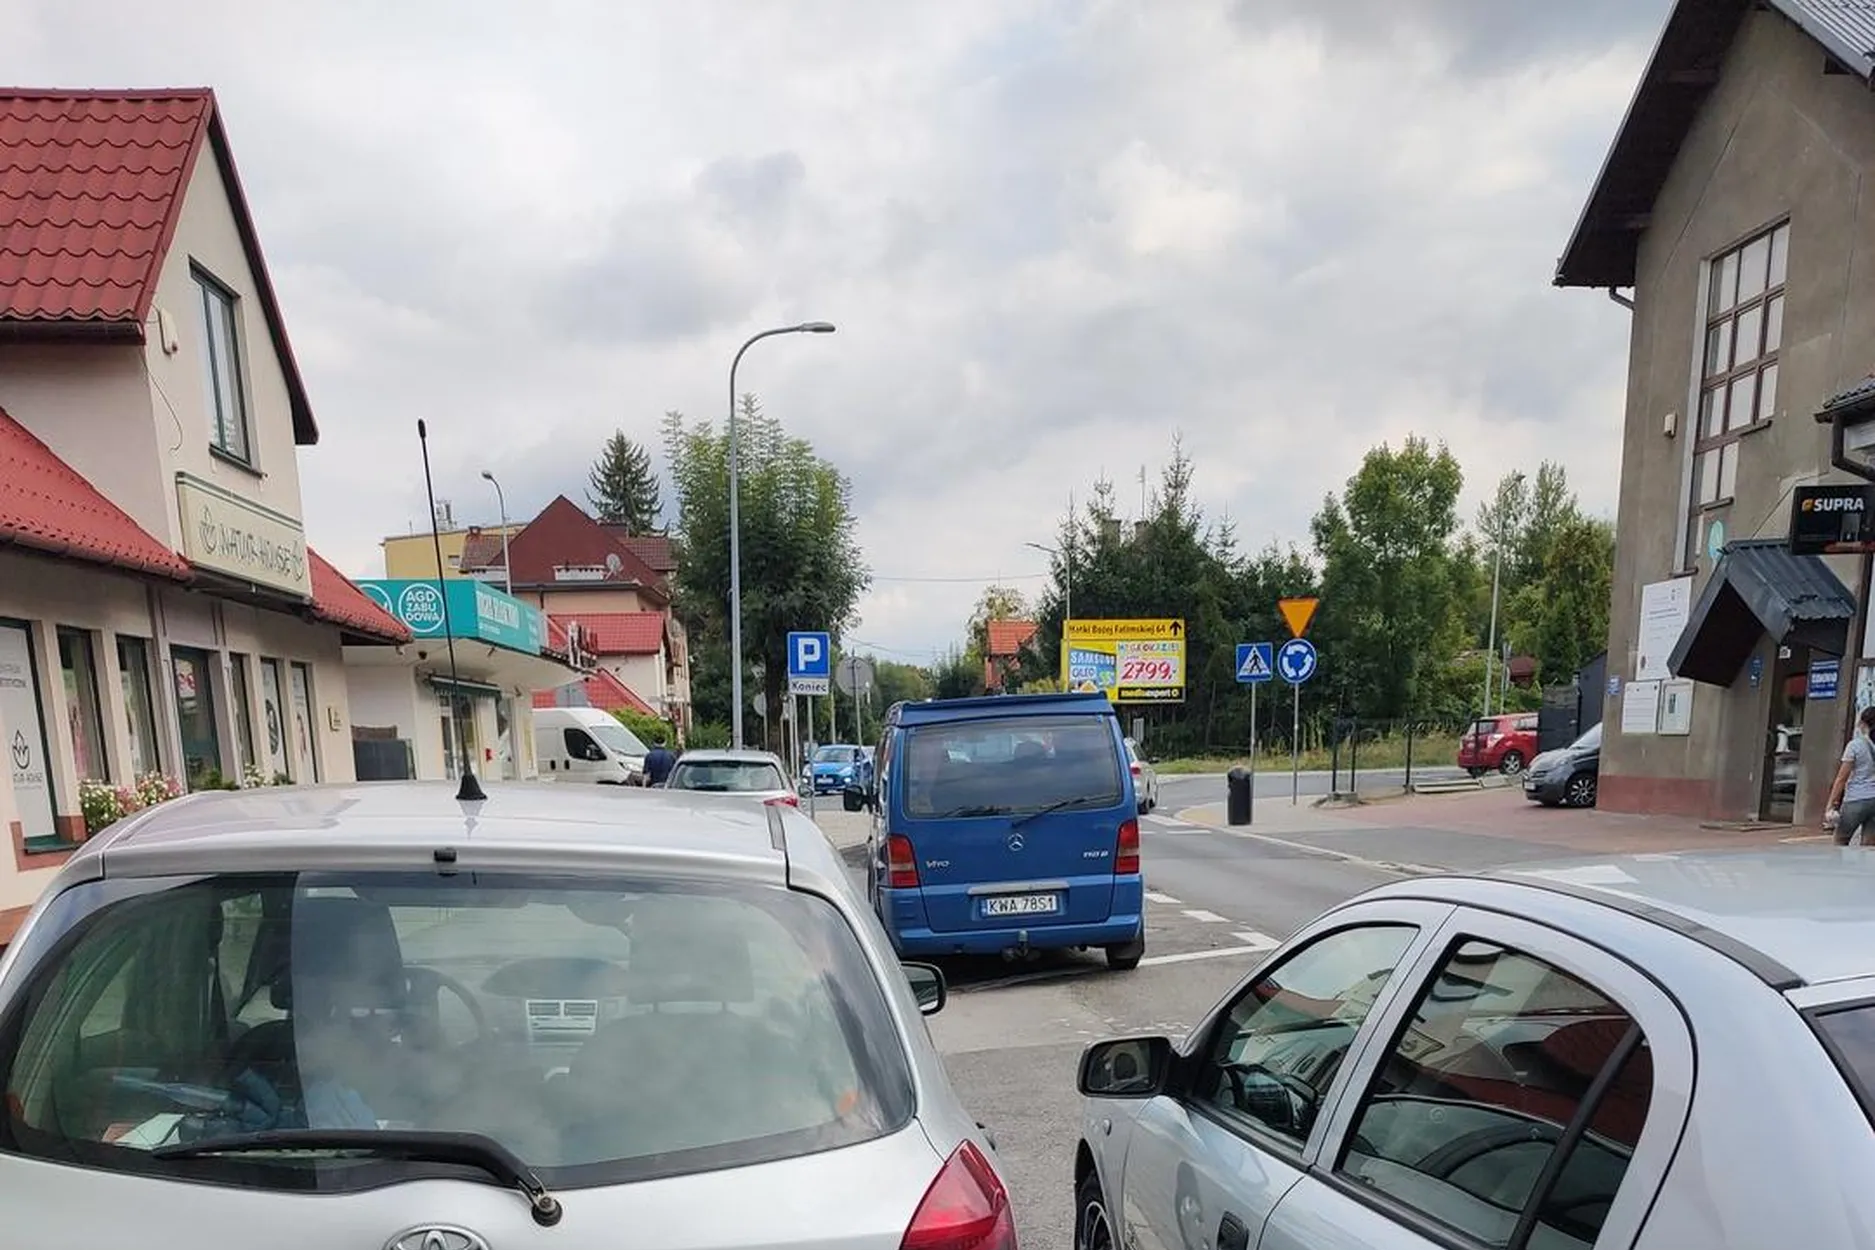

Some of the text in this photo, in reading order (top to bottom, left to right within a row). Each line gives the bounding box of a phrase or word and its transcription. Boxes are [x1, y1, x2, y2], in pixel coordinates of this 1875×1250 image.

[1813, 498, 1864, 511] SUPRA
[406, 591, 435, 602] AGD
[406, 604, 437, 613] ZABU
[406, 612, 440, 622] DOWA
[798, 638, 820, 671] P
[791, 681, 827, 691] Koniec
[989, 900, 1018, 913] KWA
[1023, 897, 1056, 911] 78S1
